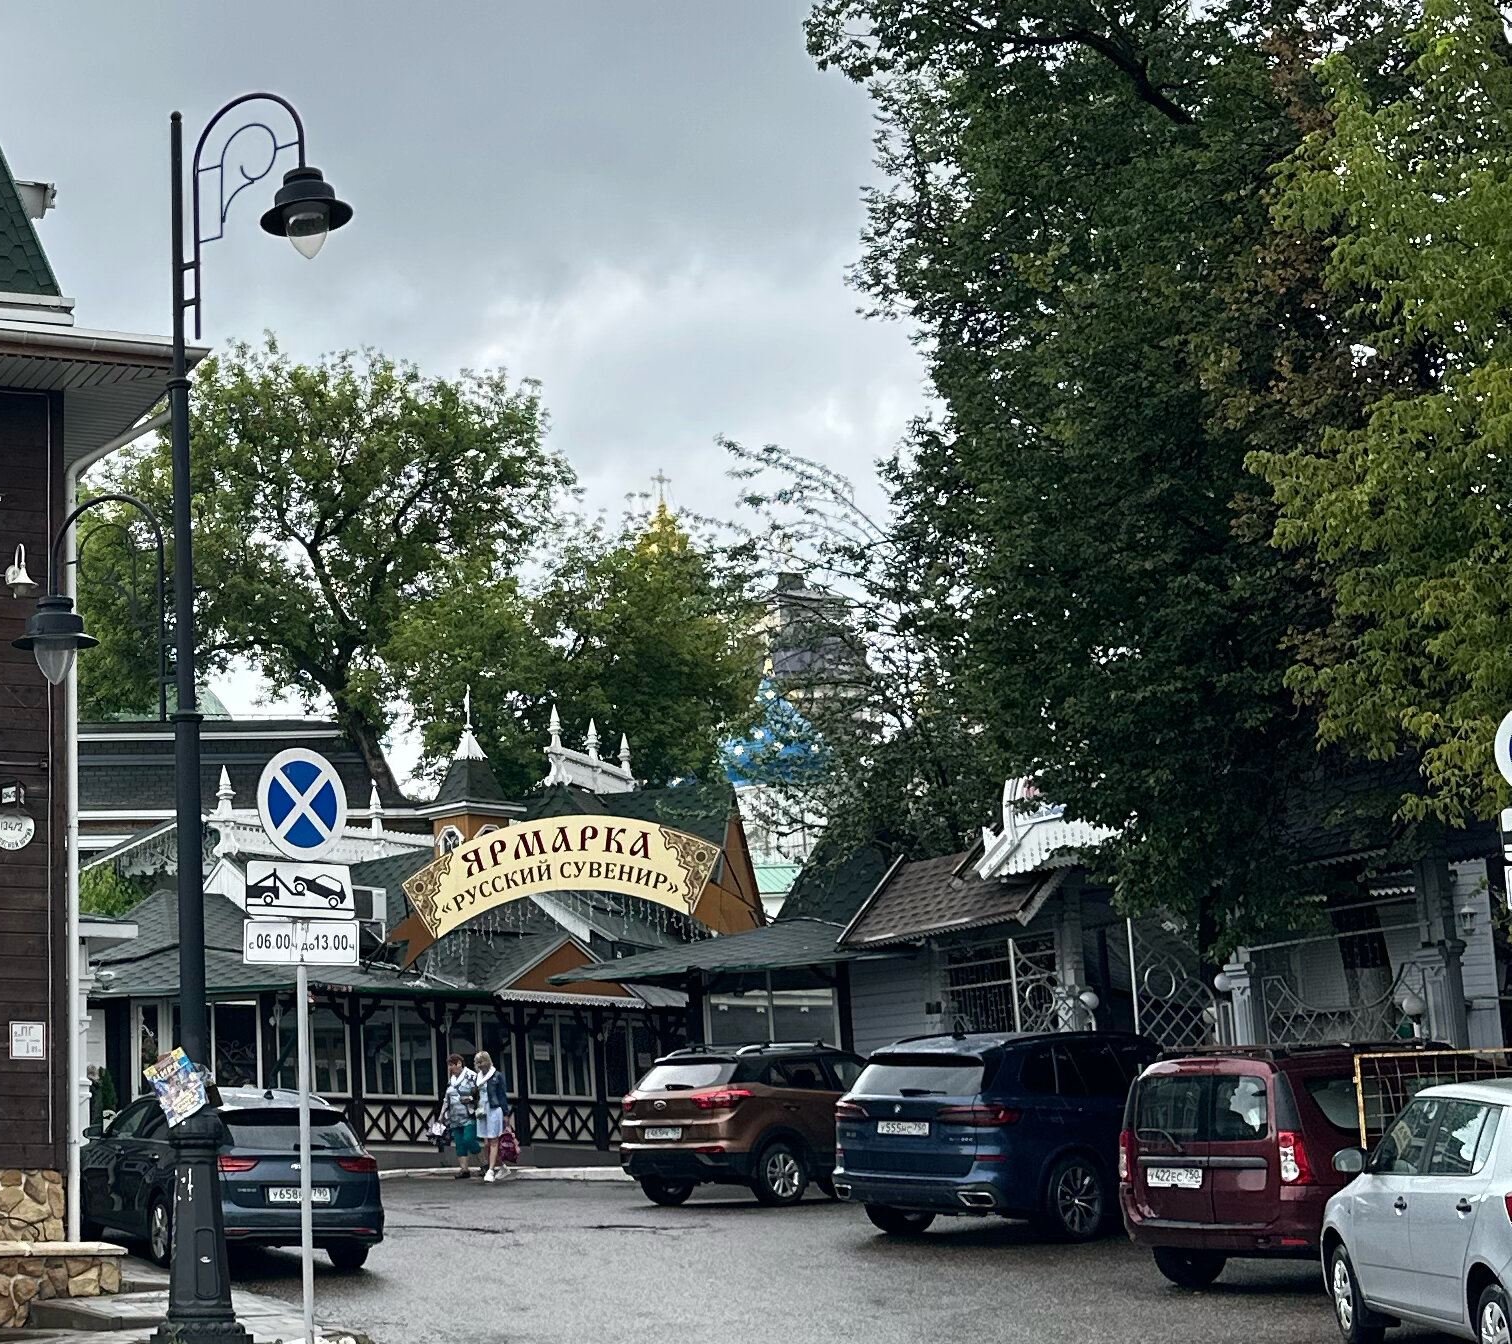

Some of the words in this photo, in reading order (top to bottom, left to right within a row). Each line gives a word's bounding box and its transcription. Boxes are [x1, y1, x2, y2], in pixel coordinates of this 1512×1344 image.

[461, 825, 651, 878] ЯРМАРКА
[441, 859, 552, 913] «РУССКИЙ
[559, 861, 679, 894] СУВЕНИР»
